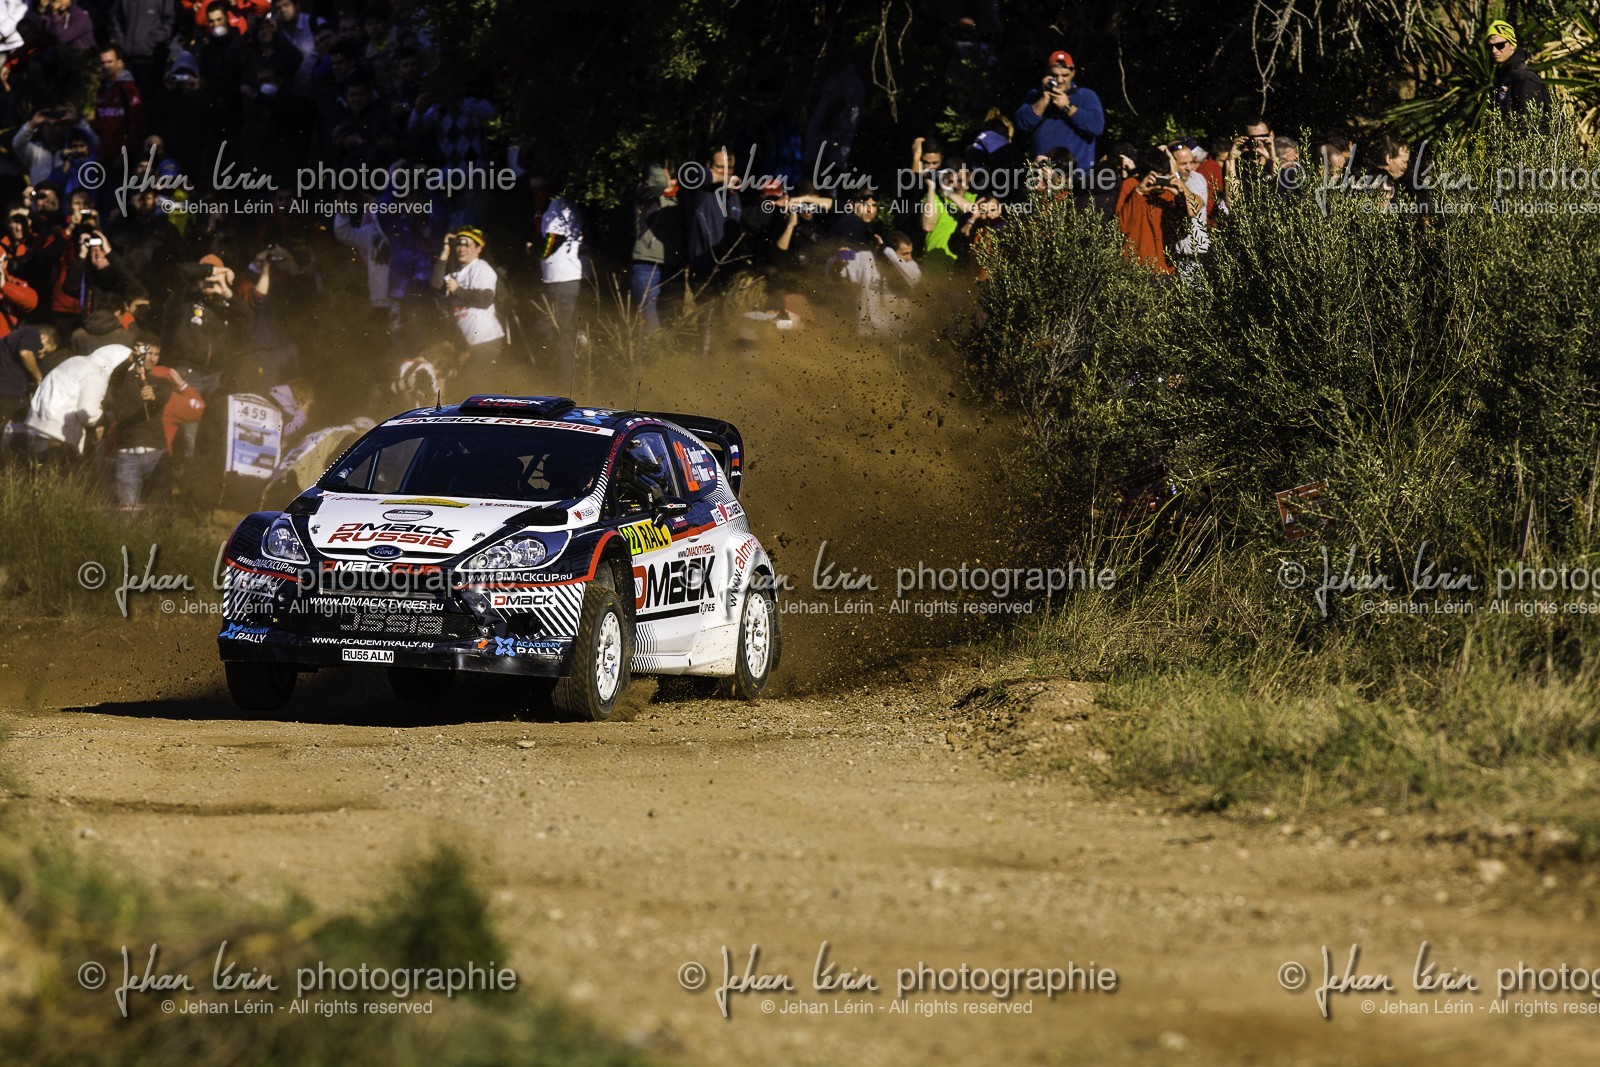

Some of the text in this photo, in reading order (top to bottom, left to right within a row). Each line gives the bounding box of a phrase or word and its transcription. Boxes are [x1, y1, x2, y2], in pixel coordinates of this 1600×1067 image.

[241, 406, 267, 420] 459
[400, 417, 600, 433] DMACK RUSSIA
[336, 523, 460, 538] DMACK
[327, 532, 454, 549] RUSSIA
[621, 526, 642, 555] 22
[373, 548, 394, 556] Ford
[632, 554, 716, 610] DMACK
[494, 594, 554, 606] DMACK
[235, 633, 267, 643] RALLY
[343, 651, 393, 662] RU55 ALM
[516, 647, 563, 655] RALLY
